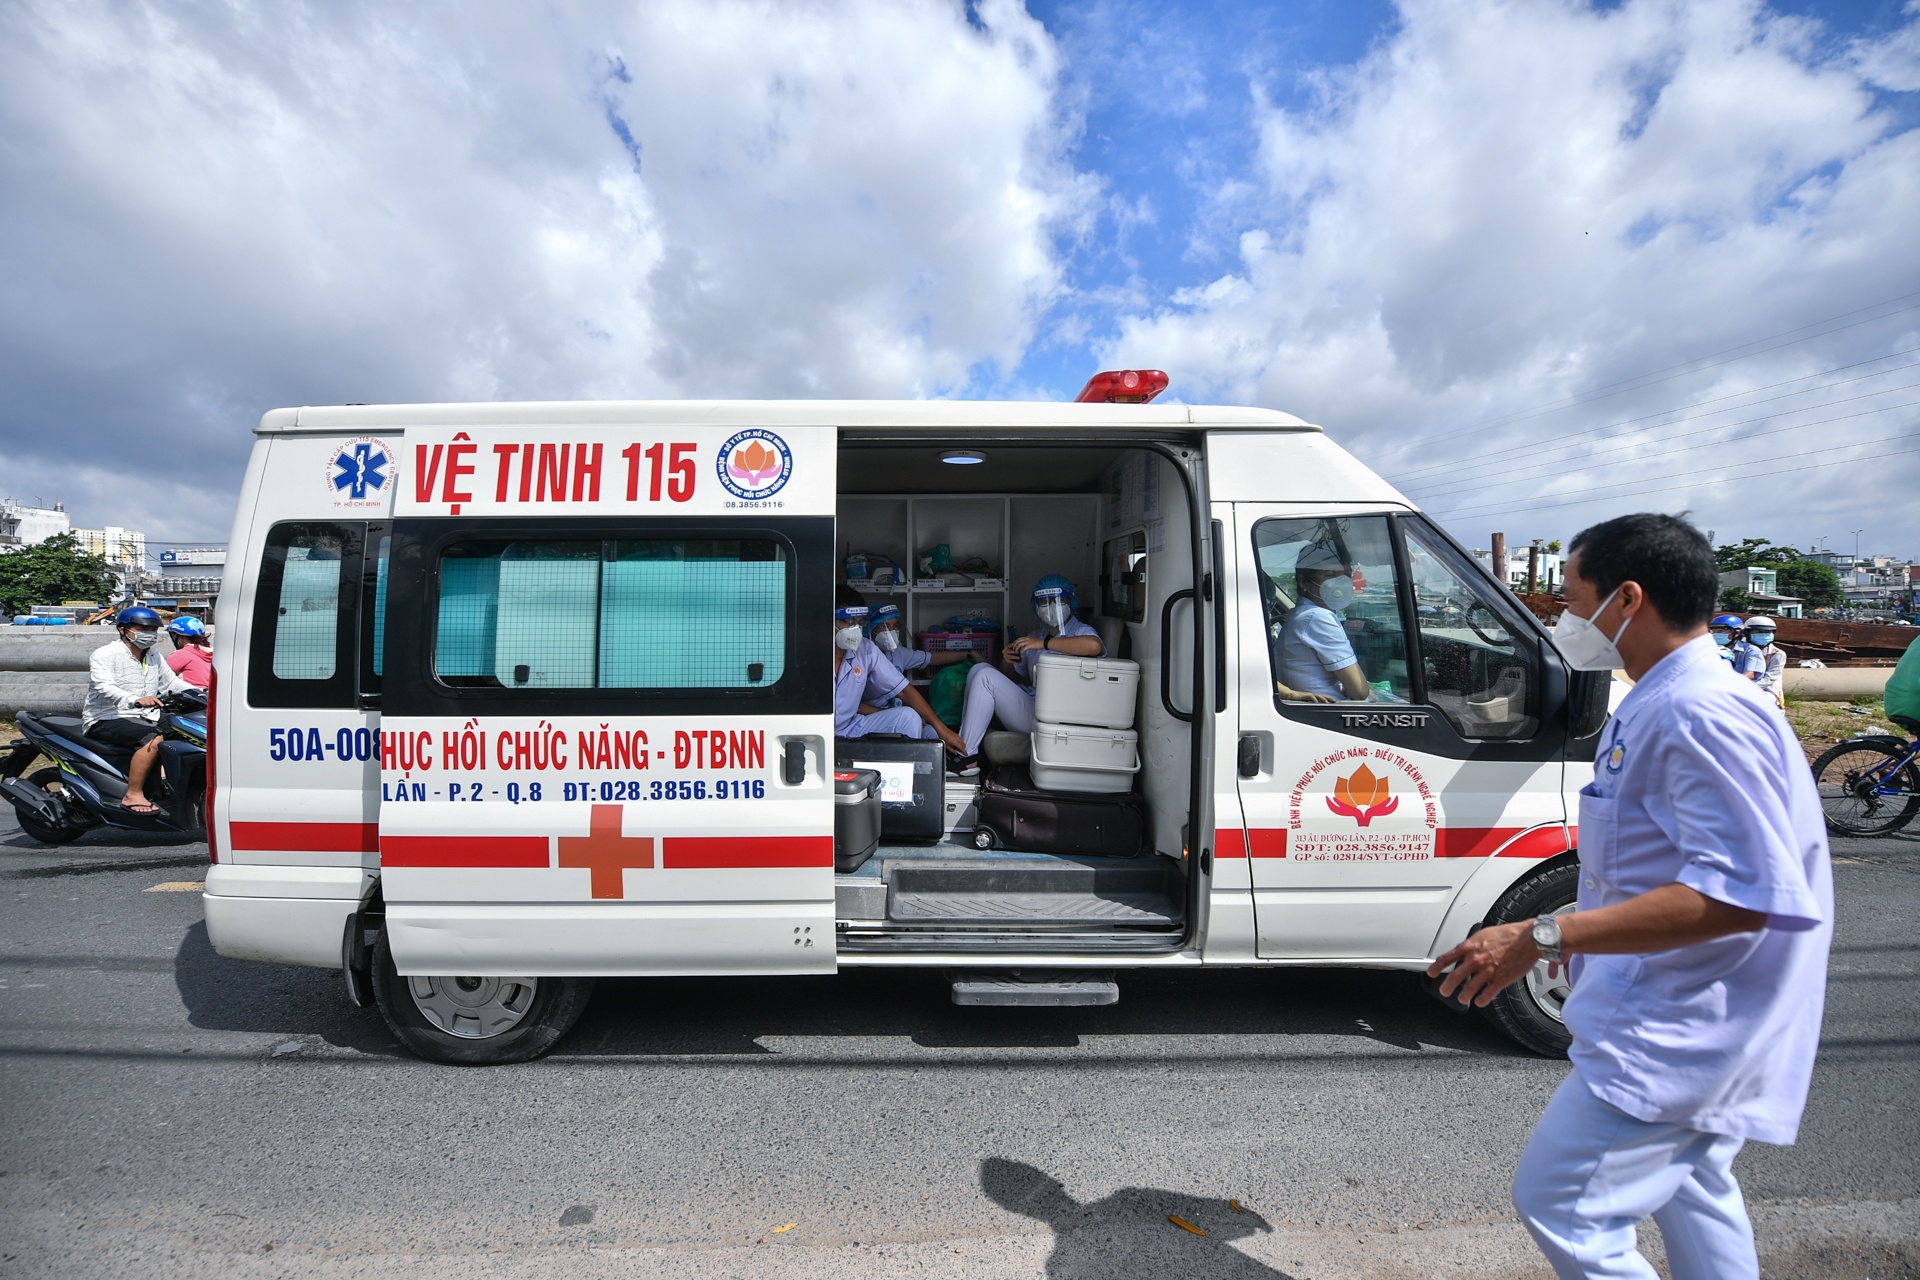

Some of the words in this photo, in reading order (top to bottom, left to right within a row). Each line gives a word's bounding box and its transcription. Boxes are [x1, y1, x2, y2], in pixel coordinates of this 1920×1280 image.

[370, 438, 395, 464] EMERGENCY
[383, 466, 395, 490] CENTER
[415, 432, 477, 515] VỆ
[492, 442, 604, 502] TINH
[622, 442, 698, 502] 115
[1342, 714, 1430, 727] TRANSIT
[381, 731, 432, 778] HỤC
[442, 718, 485, 770] HỒI
[497, 720, 567, 770] CHỨC
[579, 723, 648, 770] NĂNG
[674, 730, 764, 770] ĐTBNN
[383, 779, 426, 801] LÂN
[449, 783, 484, 801] P.2
[507, 782, 542, 804] Q.8
[1296, 771, 1314, 793] PHỤC
[1308, 833, 1319, 842] ÂU
[1321, 833, 1347, 842] DƯƠNG
[1384, 834, 1396, 842] Q.8
[1336, 843, 1430, 851] 028.3856.9147
[1295, 853, 1312, 861] GP
